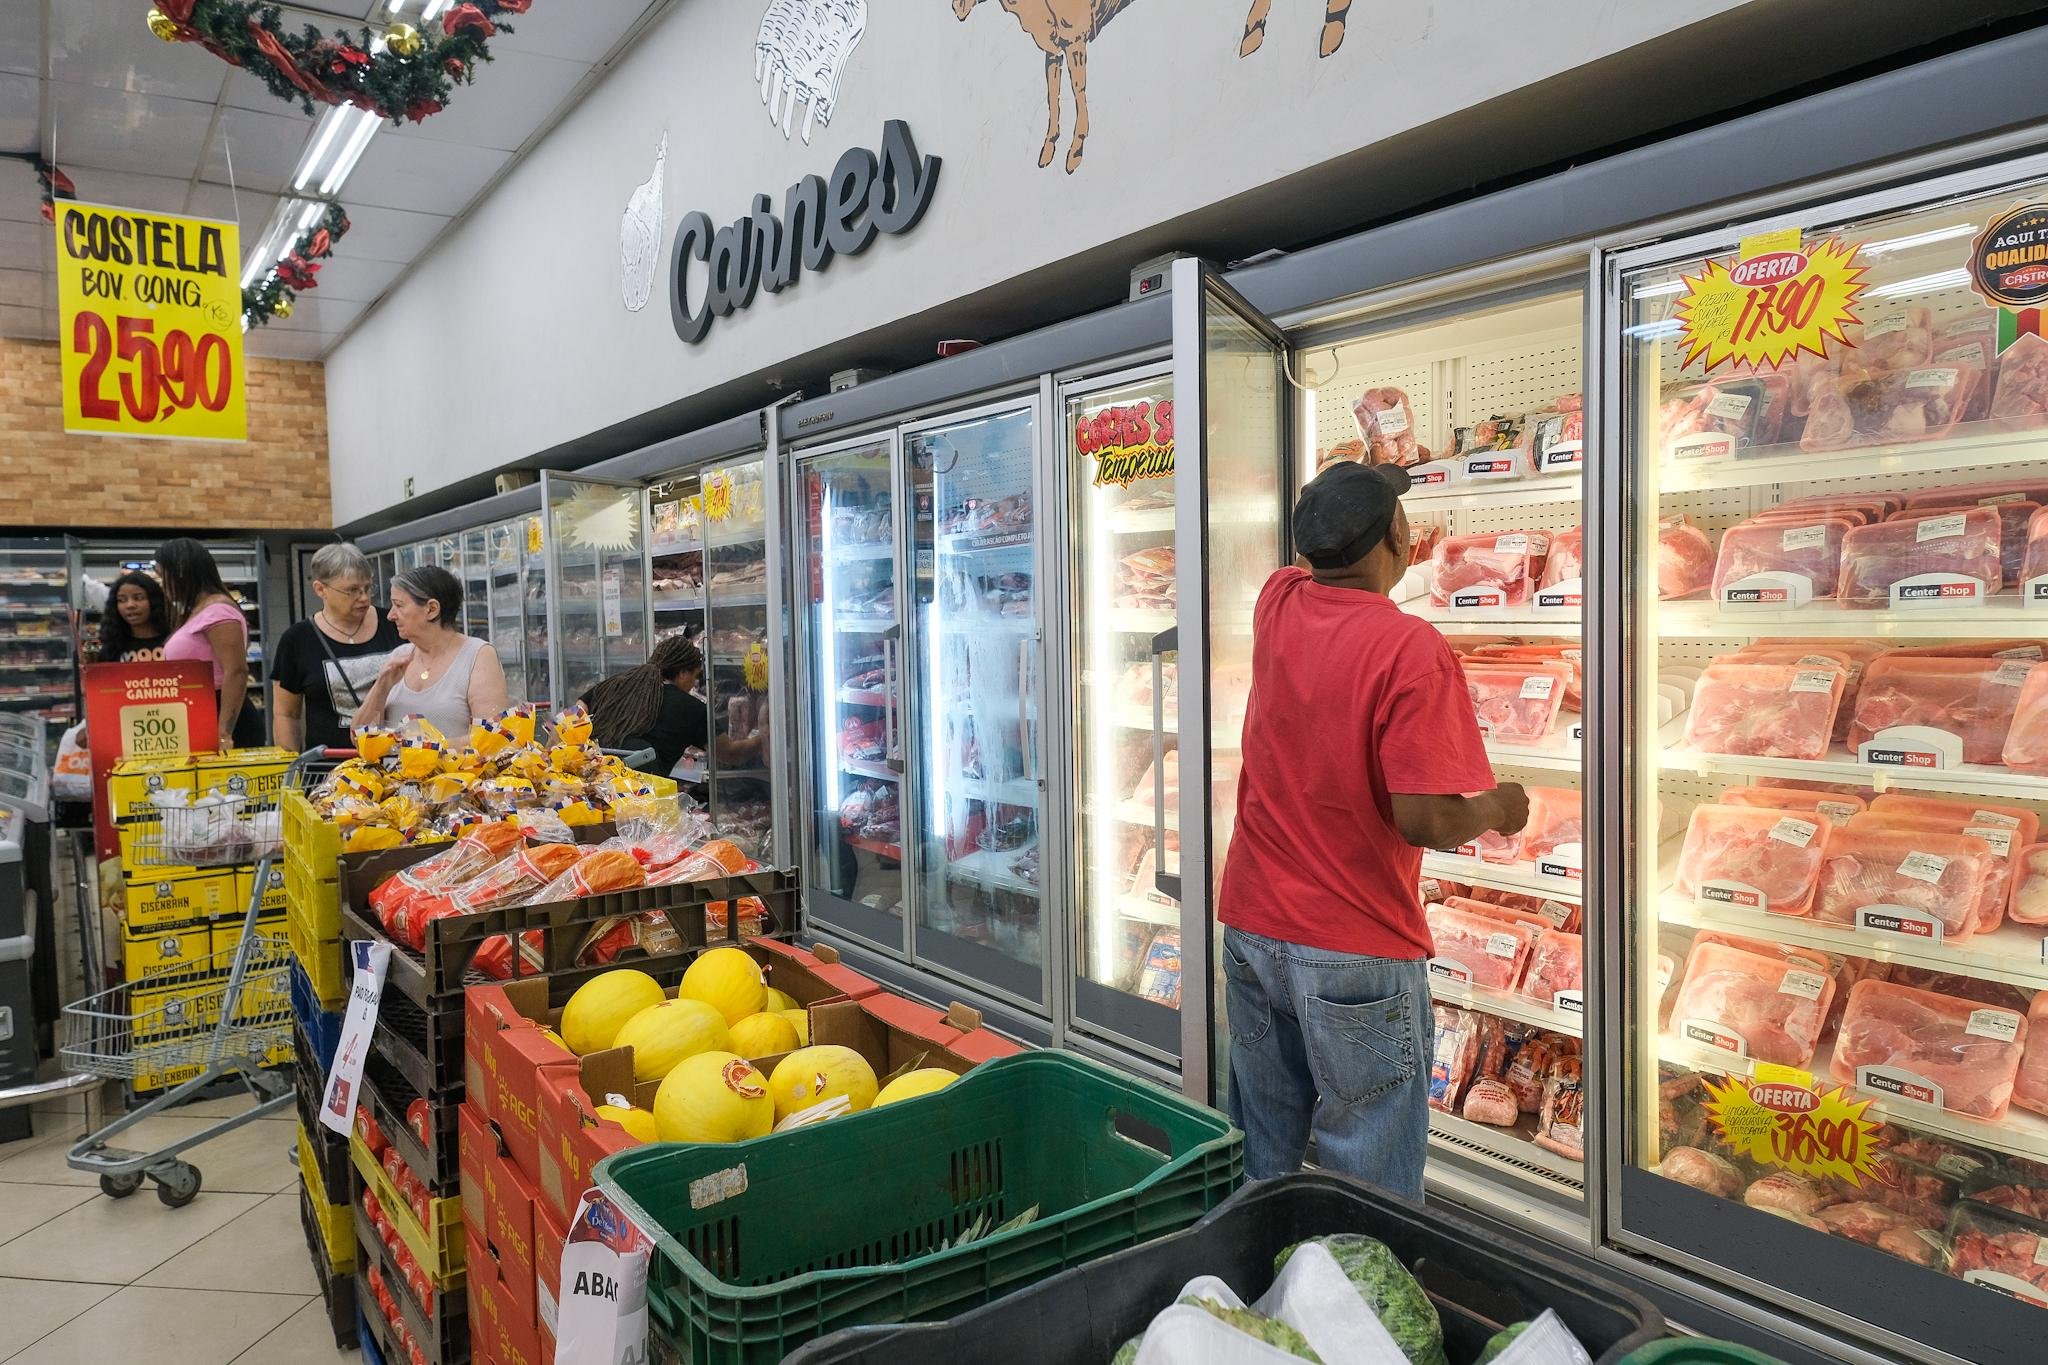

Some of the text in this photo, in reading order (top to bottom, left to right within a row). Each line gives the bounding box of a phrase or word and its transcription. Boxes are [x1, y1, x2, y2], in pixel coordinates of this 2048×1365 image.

[670, 119, 943, 344] Carnes
[64, 209, 227, 278] COSTELA
[1995, 231, 2034, 249] AQUI
[1734, 255, 1799, 284] OFERTA
[74, 311, 231, 423] 25,90
[1076, 401, 1151, 455] CORTES
[1551, 453, 1572, 462] Center
[1705, 445, 1725, 455] Shop
[1471, 462, 1508, 472] Center Shop
[1411, 475, 1442, 484] enter Shop
[1731, 591, 1783, 600] Center Shop
[1905, 586, 1970, 597] Center Shop
[1458, 596, 1496, 605] Center Shop
[1542, 596, 1582, 605] Center Shop
[125, 677, 178, 688] VOCÊ PODE
[126, 687, 179, 700] GANHAR
[133, 718, 176, 737] 500
[133, 736, 179, 752] REAIS
[1872, 752, 1931, 765] Center Shop
[1458, 847, 1473, 856] Shop
[1544, 865, 1565, 875] Center
[1705, 889, 1755, 904] Center Shop
[140, 897, 190, 914] EISENBAHN
[1868, 916, 1928, 934] Center Shop
[1432, 966, 1464, 980] Center Shop
[1689, 1028, 1735, 1049] Center Shop
[150, 1067, 201, 1087] EIENBAHN
[1870, 1076, 1928, 1101] Center Shop
[1752, 1087, 1812, 1109] OFERTA
[509, 1094, 537, 1131] AGC
